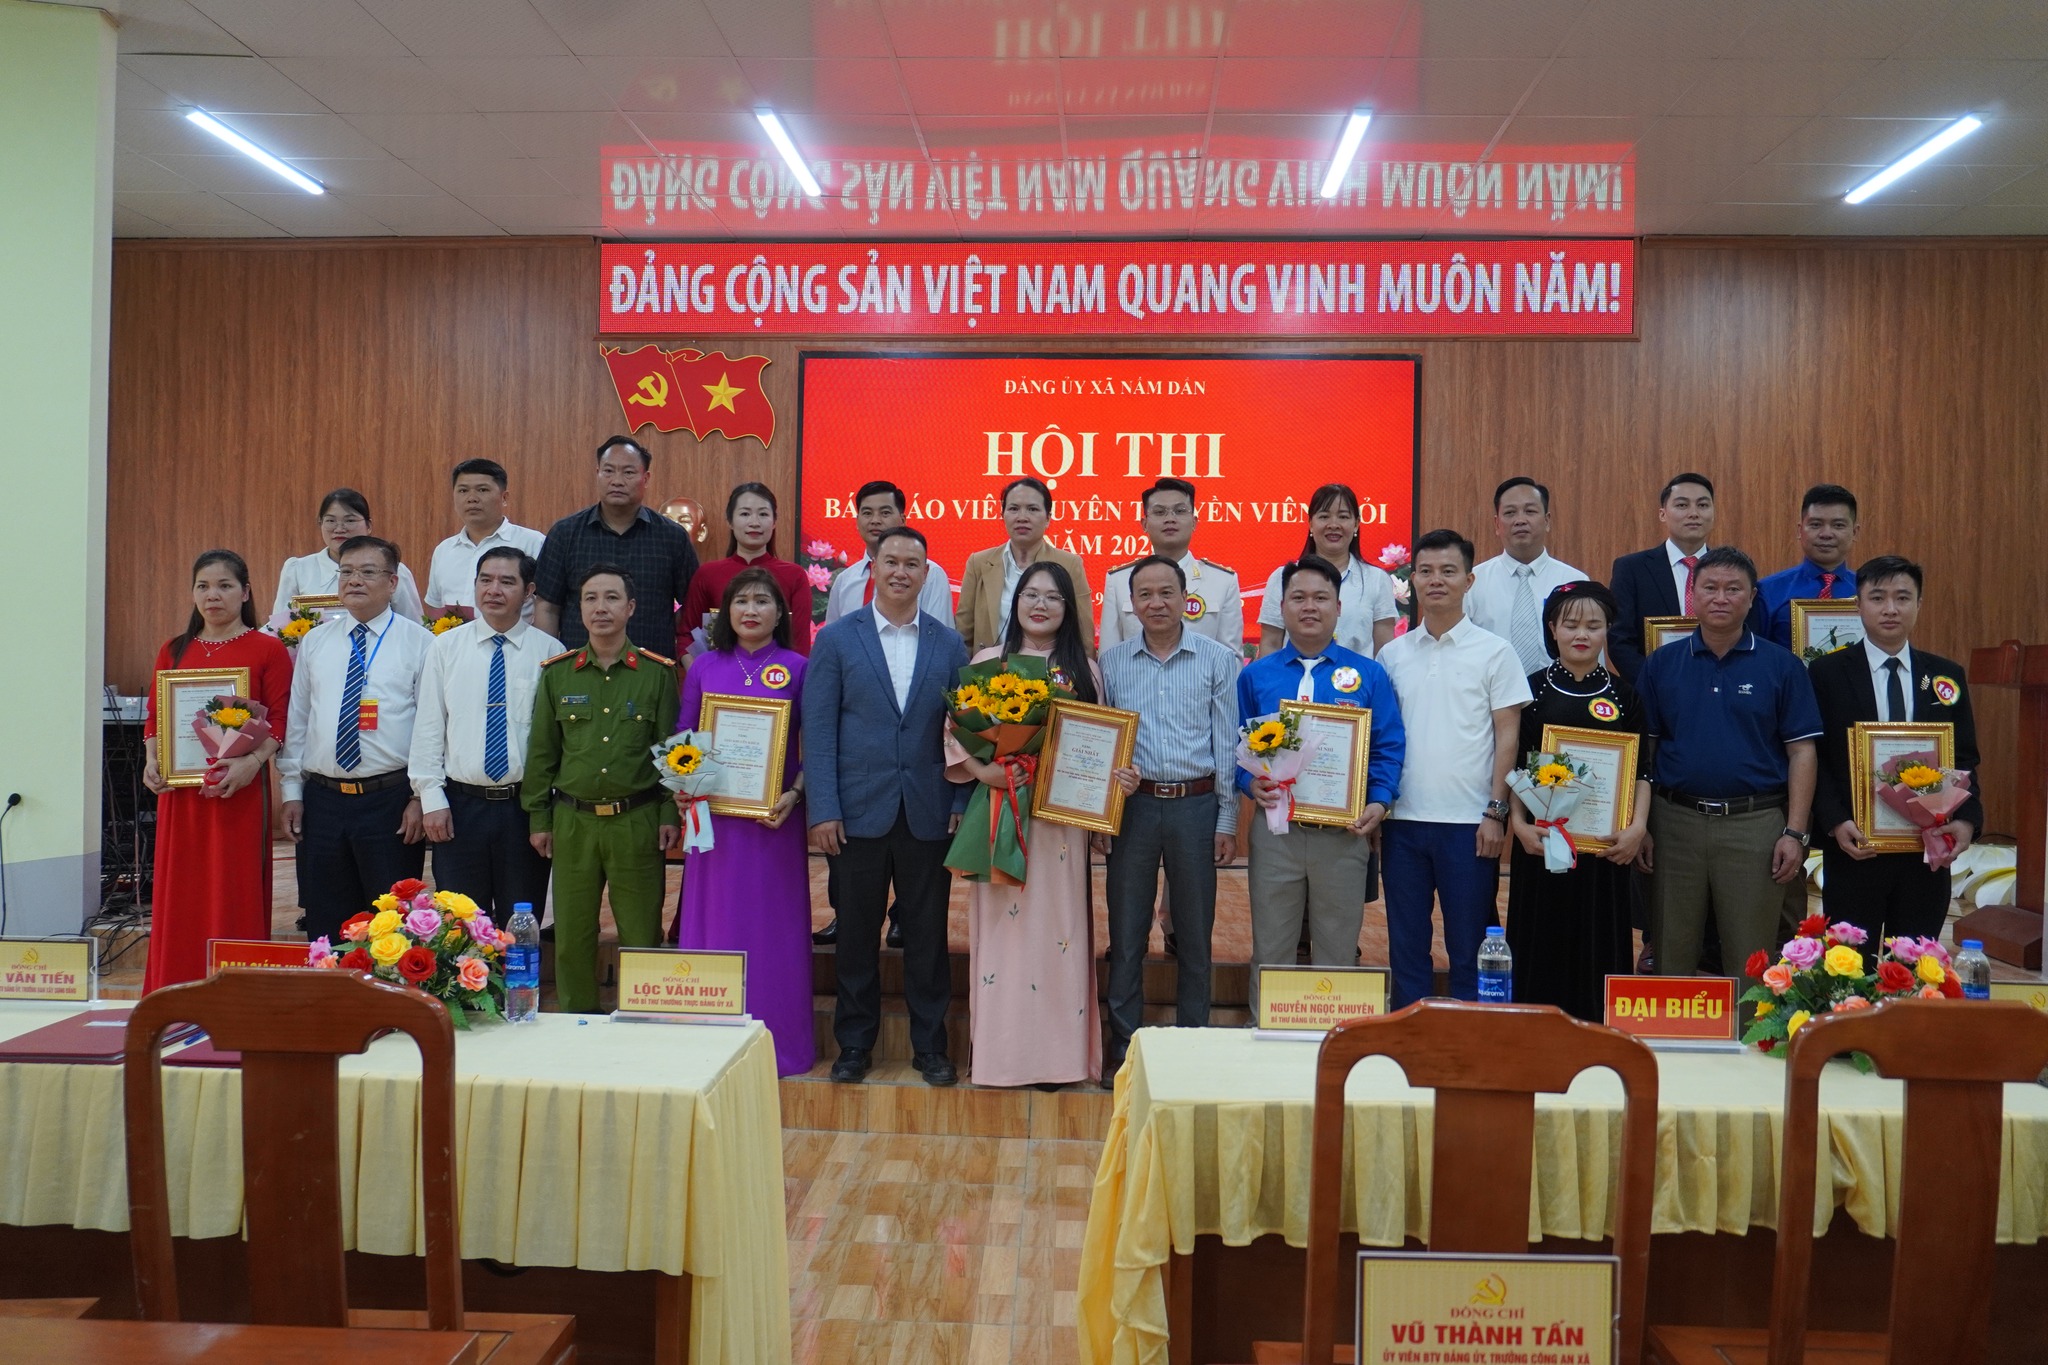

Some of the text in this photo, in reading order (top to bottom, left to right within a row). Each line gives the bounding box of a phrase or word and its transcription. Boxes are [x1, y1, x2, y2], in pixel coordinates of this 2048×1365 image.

[609, 249, 1622, 328] ĐẢNG CỘNG SẢN VIỆT NAM QUANG VINH MUÔN NĂM!
[1004, 376, 1056, 395] ĐẢNG
[1061, 376, 1085, 395] ỦY
[1090, 376, 1115, 395] XÃ
[982, 424, 1226, 490] HỘI THI
[824, 493, 858, 518] BÁ
[906, 493, 945, 520] ÁO
[952, 493, 1005, 520] VIÊ
[1050, 494, 1123, 521] UYÊN
[1110, 535, 1156, 556] 202
[1186, 601, 1200, 613] 19
[768, 672, 784, 683] 16
[1595, 704, 1612, 716] 21
[6, 971, 75, 984] VĂN TIẾN
[634, 983, 728, 997] LỘC VĂN HUY
[1270, 1000, 1374, 1016] NGUYỄN NGỌC KHUYÊN
[1615, 990, 1723, 1022] ĐẠI BIỂU
[1450, 1306, 1525, 1320] ĐỒNG CHÍ
[1391, 1319, 1584, 1346] VŨ THÀNH TẤN
[1424, 1352, 1441, 1364] BTV
[1561, 1353, 1575, 1365] AN
